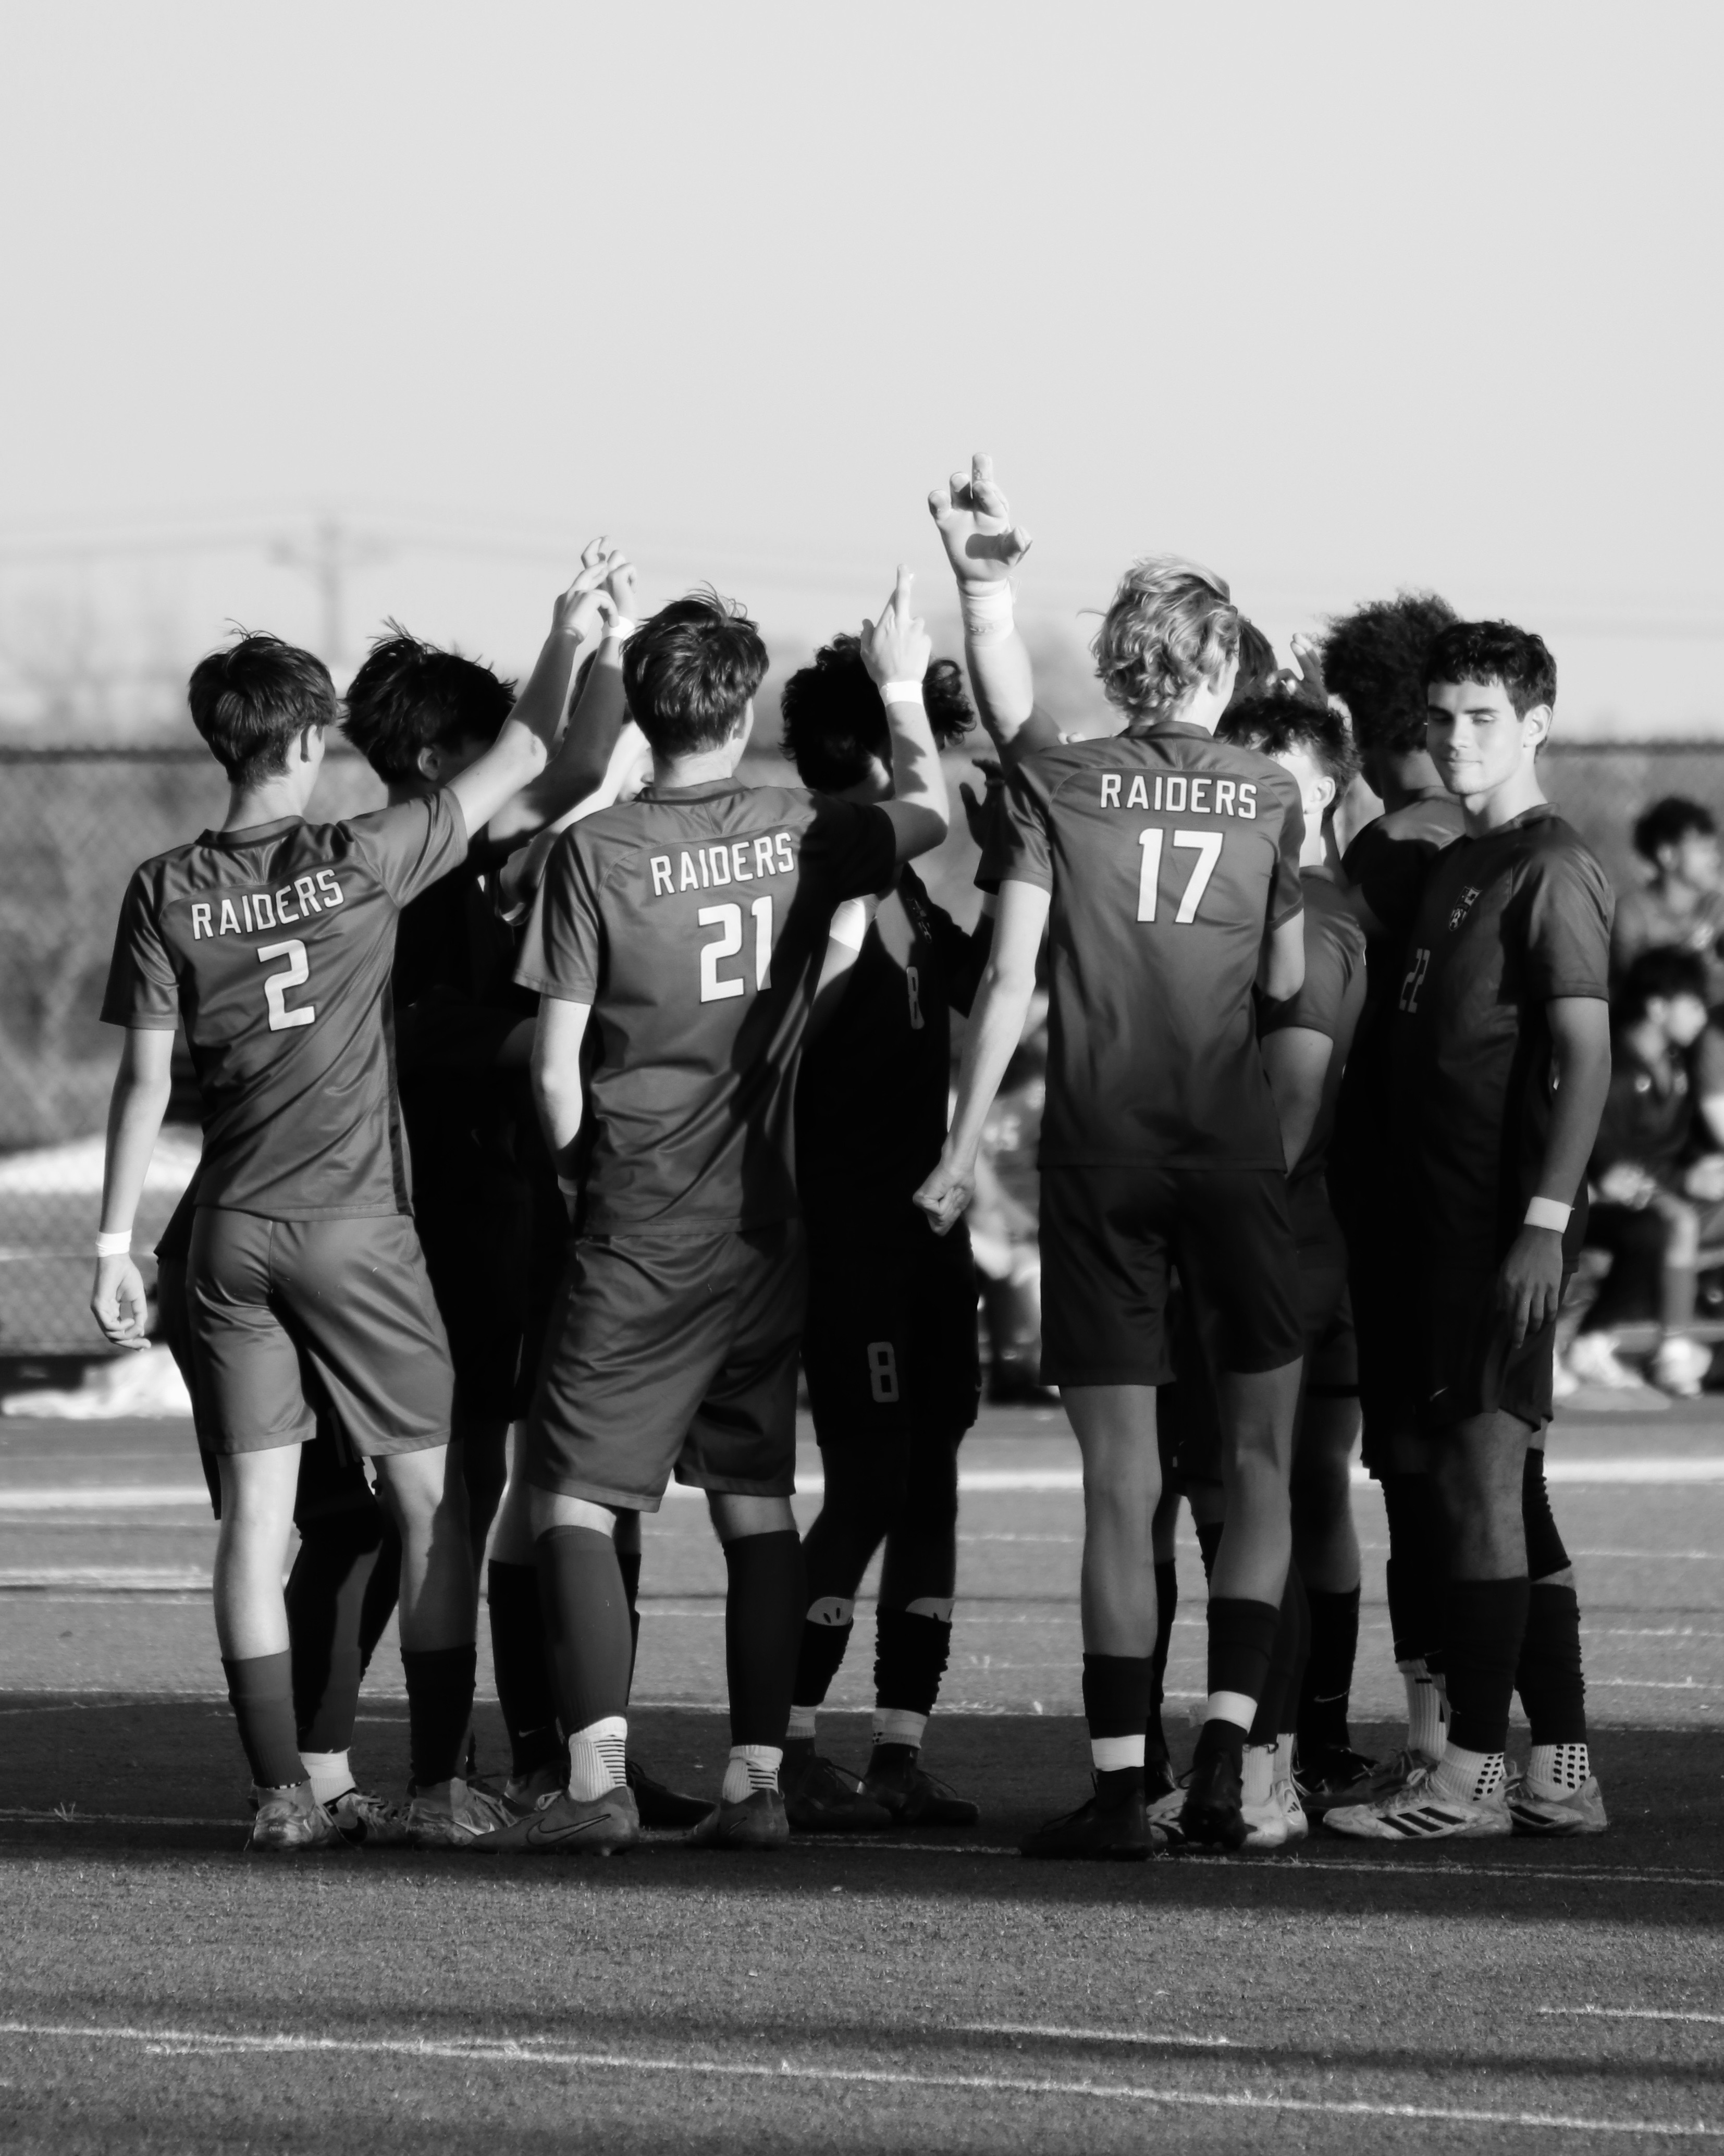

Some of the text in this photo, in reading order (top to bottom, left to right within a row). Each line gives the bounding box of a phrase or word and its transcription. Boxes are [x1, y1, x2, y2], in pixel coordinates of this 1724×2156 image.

[1100, 774, 1257, 819] RAIDERS
[650, 833, 794, 896] RAIDERS
[1138, 828, 1223, 923] 17
[192, 869, 344, 939] RAIDERS
[698, 896, 772, 1003] 21
[1399, 947, 1431, 1013] 22
[257, 939, 315, 1031] 2
[906, 966, 925, 1030] 8
[867, 1341, 900, 1403] 8
